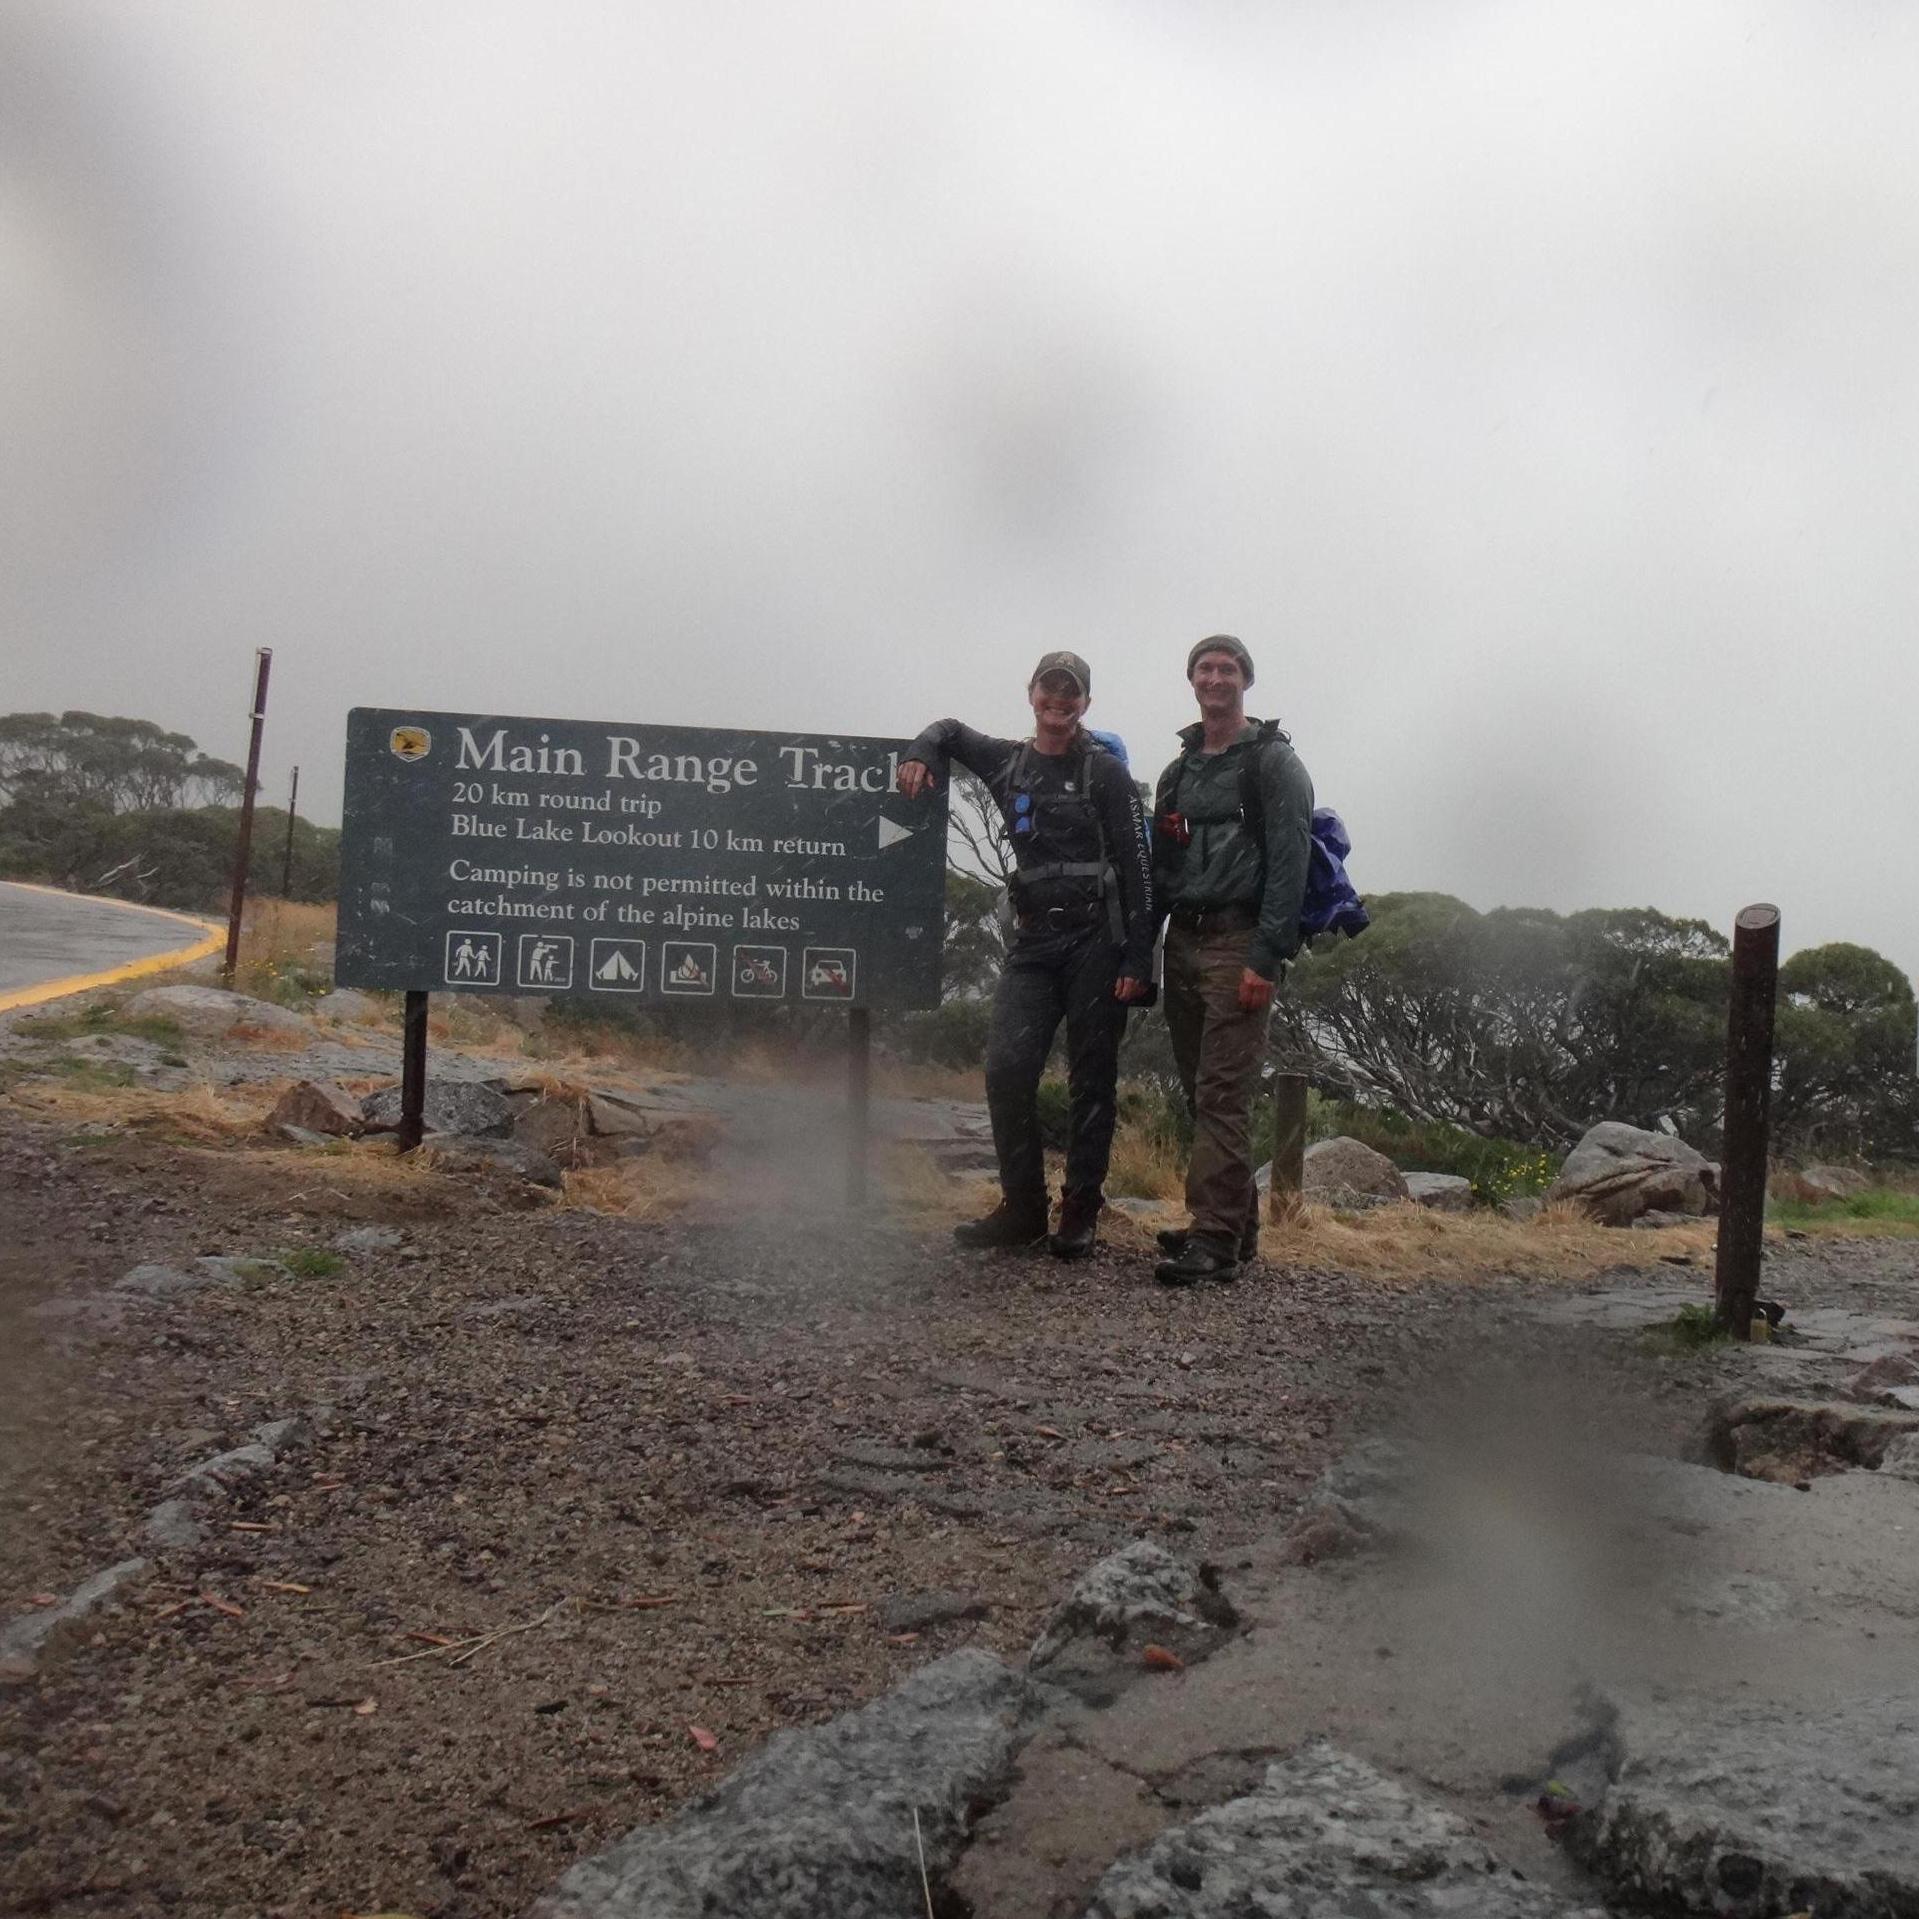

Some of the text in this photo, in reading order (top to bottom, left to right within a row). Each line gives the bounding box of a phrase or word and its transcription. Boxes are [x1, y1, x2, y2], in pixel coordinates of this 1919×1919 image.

[455, 727, 585, 776] Main
[605, 736, 758, 794] Range
[453, 782, 662, 819] 20 km round trip
[451, 814, 847, 857] Blue Lake Lookout 10 km return
[450, 859, 885, 903] Camping is not permitted within the
[448, 895, 800, 931] catchment of the alpine lakes
